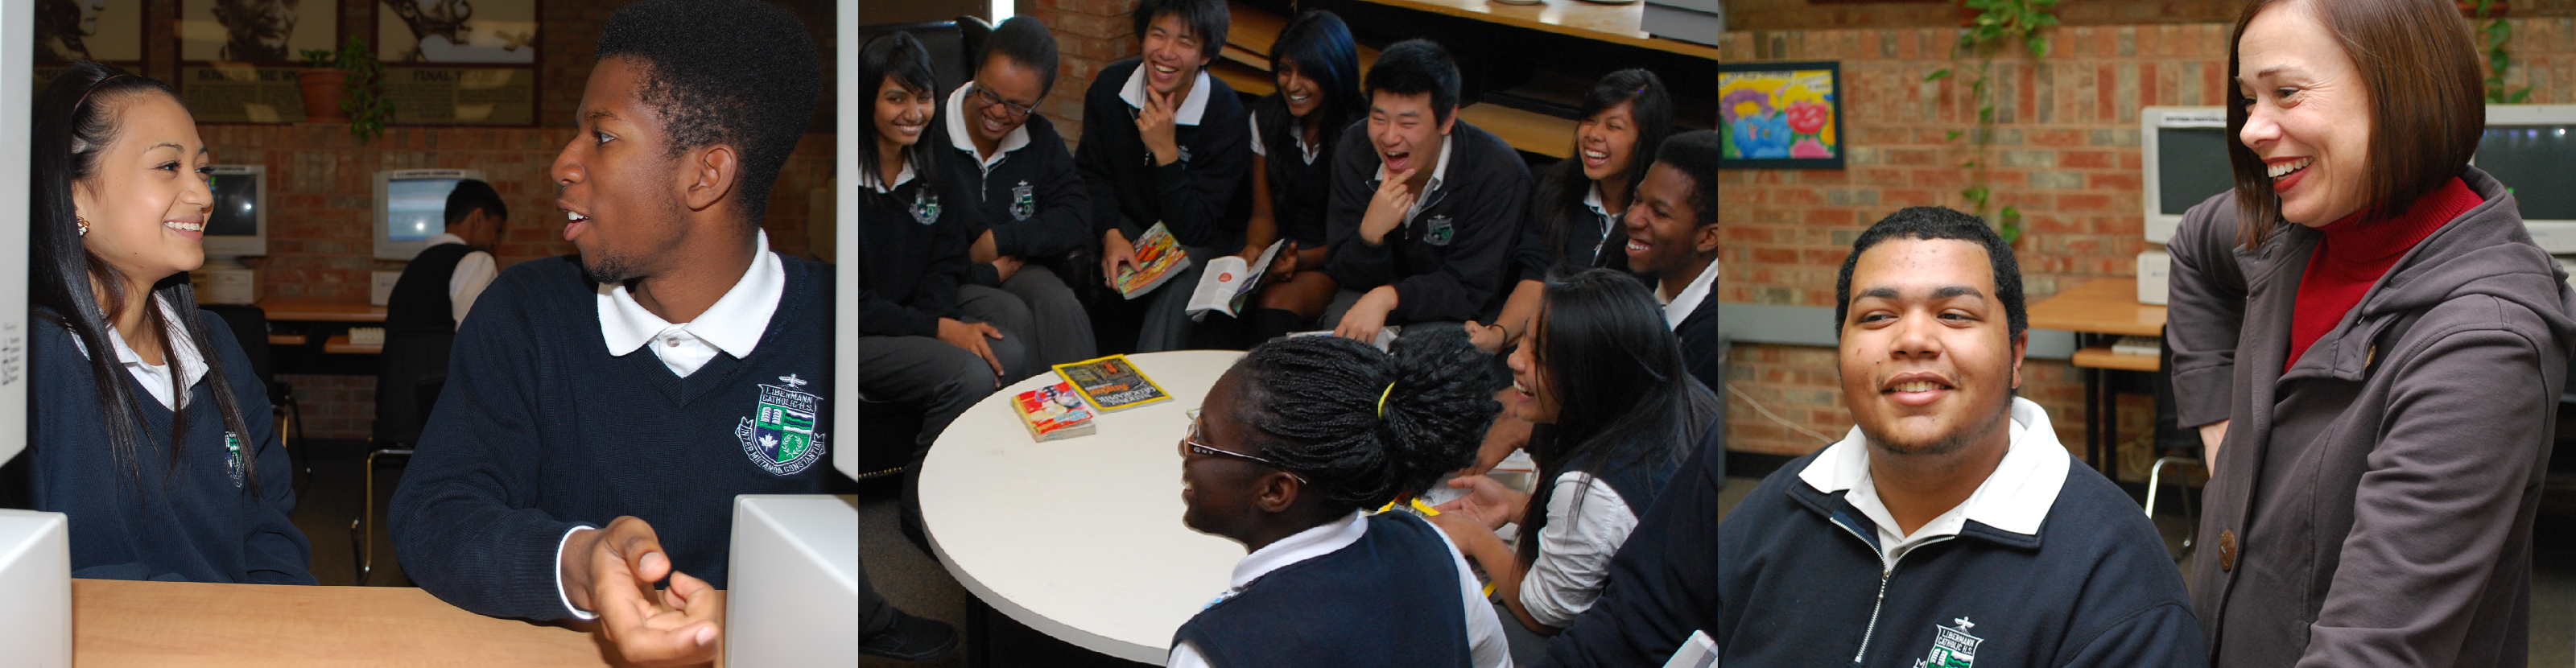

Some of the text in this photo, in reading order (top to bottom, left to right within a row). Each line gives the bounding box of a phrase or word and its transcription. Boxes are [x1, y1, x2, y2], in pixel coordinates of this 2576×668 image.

[257, 69, 278, 80] THE
[413, 70, 452, 80] FINAL
[762, 394, 798, 407] CATHOLIC
[766, 386, 812, 404] LIBERMANN
[741, 427, 753, 452] INTER
[783, 441, 822, 473] CONSTANTIA
[1938, 637, 1963, 651] CATHOLIC
[1942, 629, 1975, 647] LIBERMANN
